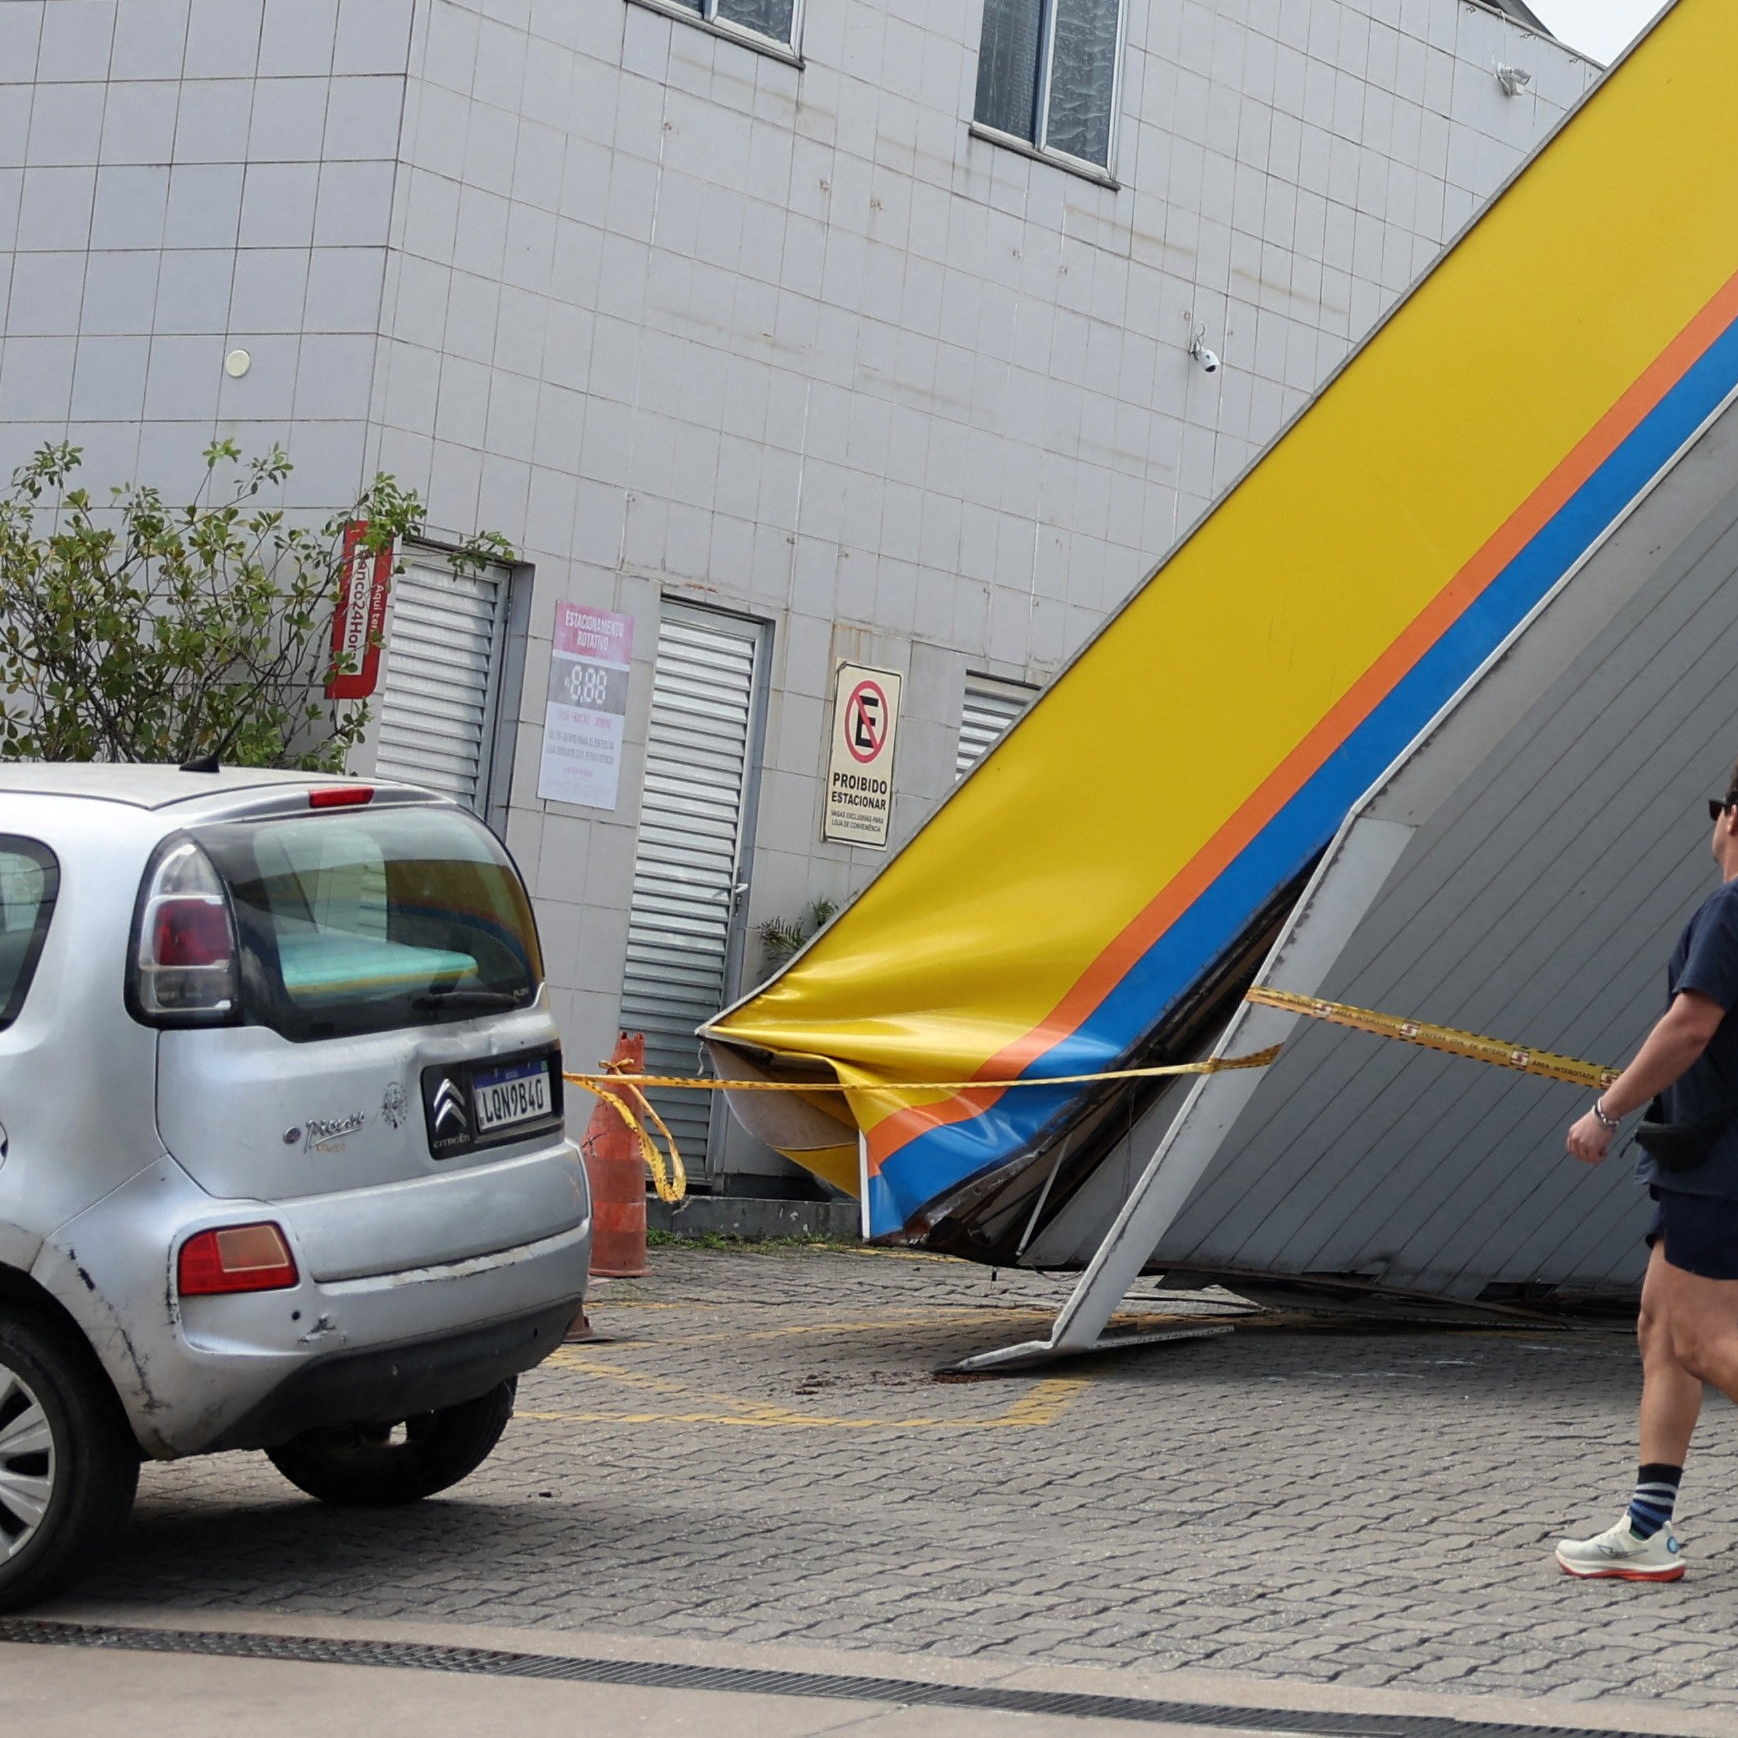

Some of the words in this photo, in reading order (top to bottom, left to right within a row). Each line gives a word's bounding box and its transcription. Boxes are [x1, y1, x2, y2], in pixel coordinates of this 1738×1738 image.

[347, 550, 368, 661] anco24Hor
[372, 584, 385, 613] Aqui
[565, 609, 624, 639] ESTACIONAMENTO
[577, 630, 609, 651] ROTATIVO
[832, 772, 888, 795] PROIBIDO
[831, 791, 887, 811] ESTACIONAR
